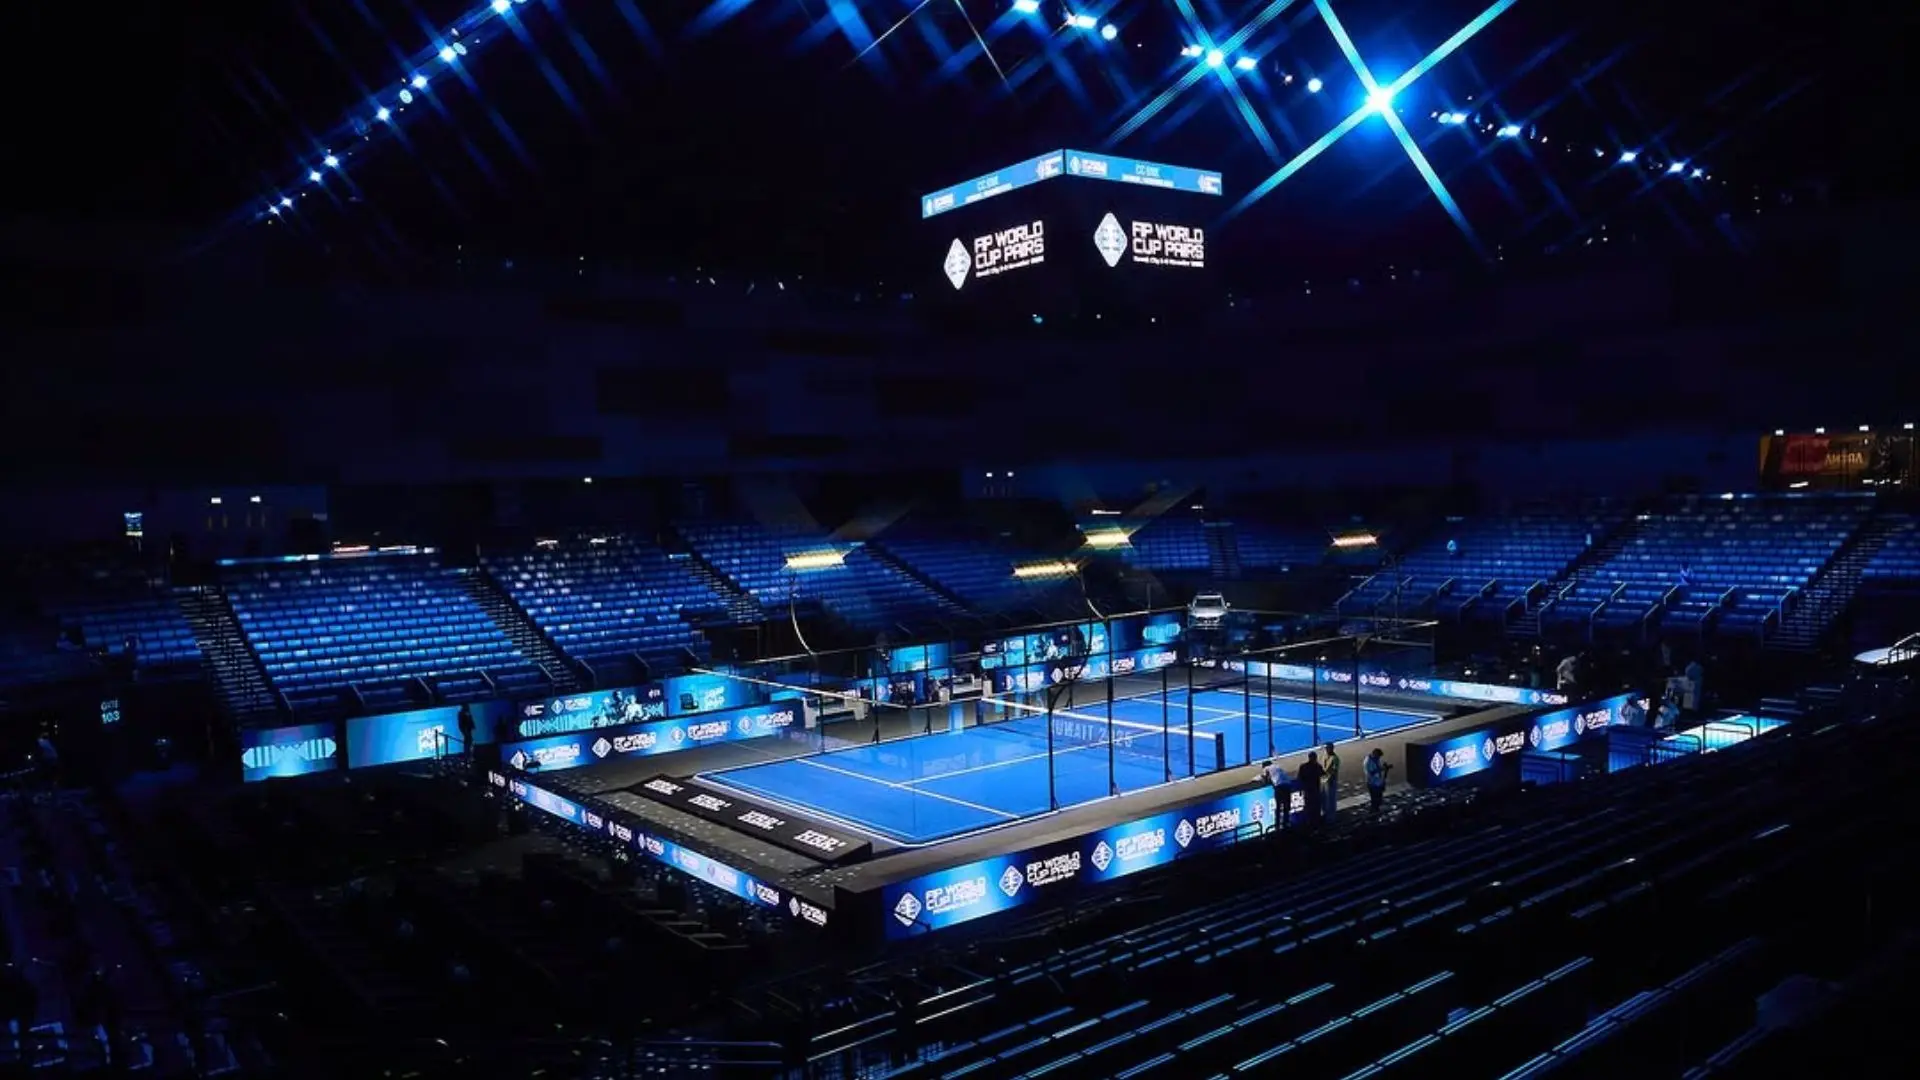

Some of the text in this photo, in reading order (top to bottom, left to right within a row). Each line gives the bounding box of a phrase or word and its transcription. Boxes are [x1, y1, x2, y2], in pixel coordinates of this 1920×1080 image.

[995, 220, 1043, 247] WORLD
[1155, 223, 1204, 245] WORLD
[975, 248, 1001, 270] CUP
[1004, 237, 1044, 262] PAIRS
[1132, 237, 1162, 255] CUP
[1164, 241, 1204, 259] PAIRS
[102, 710, 120, 724] 103
[1043, 851, 1080, 868] WORLD
[1027, 869, 1049, 883] CUP
